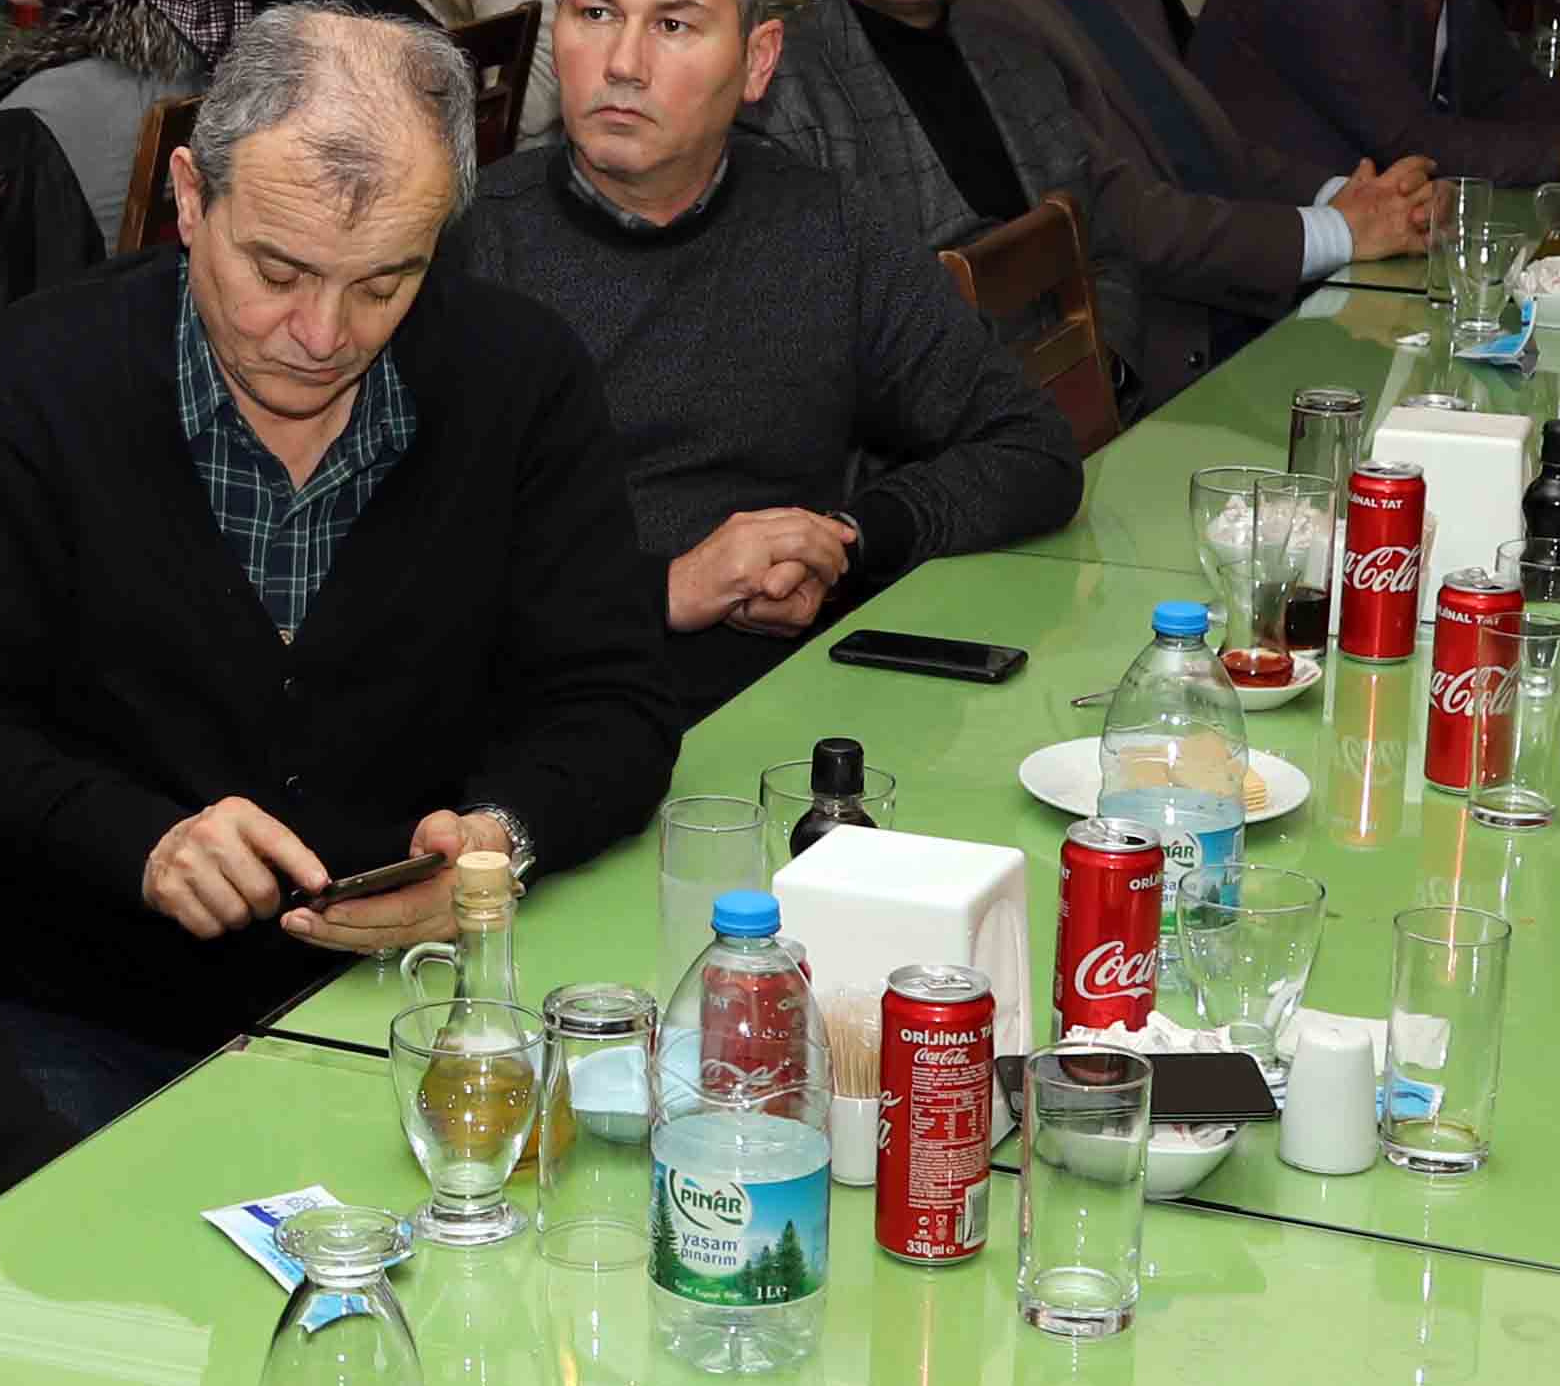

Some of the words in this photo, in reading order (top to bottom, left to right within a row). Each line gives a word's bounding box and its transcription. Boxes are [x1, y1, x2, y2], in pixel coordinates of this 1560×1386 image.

[1381, 499, 1403, 509] TAT
[900, 1029, 977, 1046] ORİJİNAL
[681, 1187, 742, 1214] PINAR
[906, 1239, 930, 1255] 330
